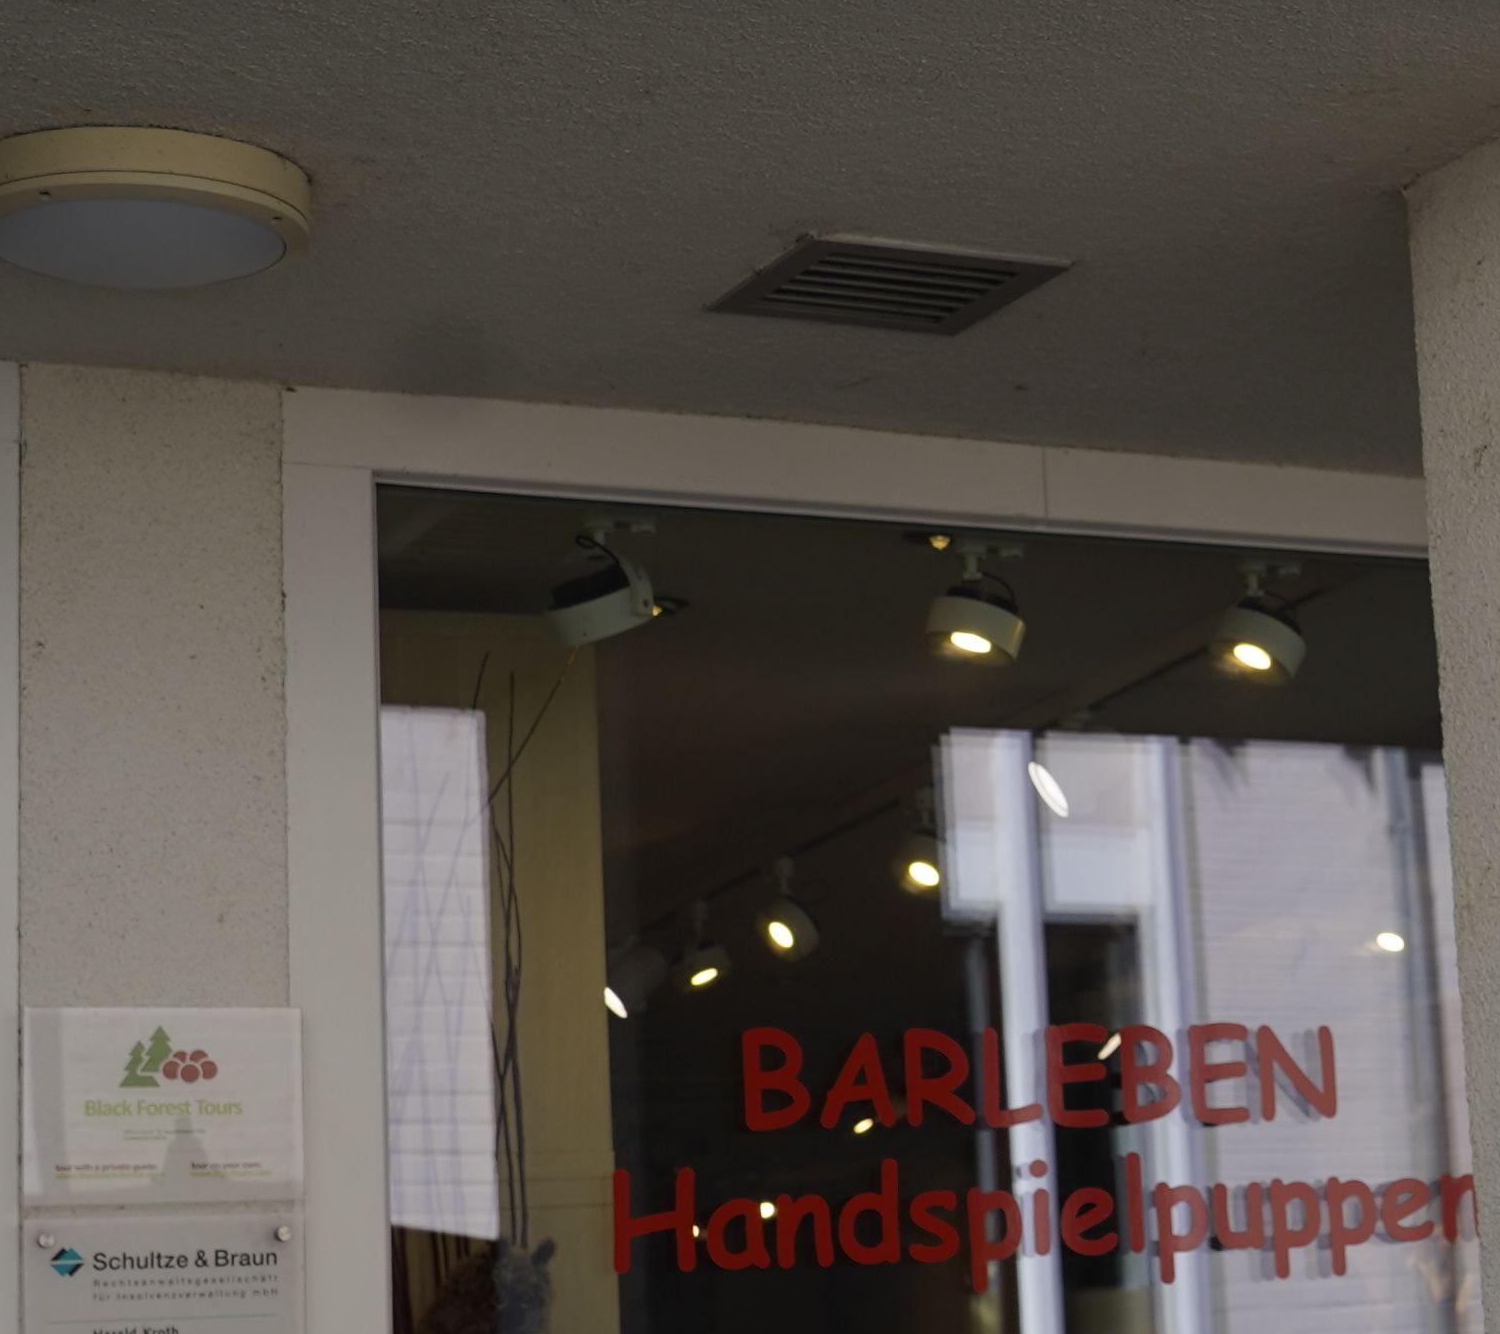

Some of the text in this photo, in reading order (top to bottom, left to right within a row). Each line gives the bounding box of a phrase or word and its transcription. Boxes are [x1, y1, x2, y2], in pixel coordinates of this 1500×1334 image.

[742, 1023, 1338, 1131] BARLEBEN
[84, 1099, 243, 1116] Black Forest Tours
[93, 1249, 278, 1271] Schultze & Braun
